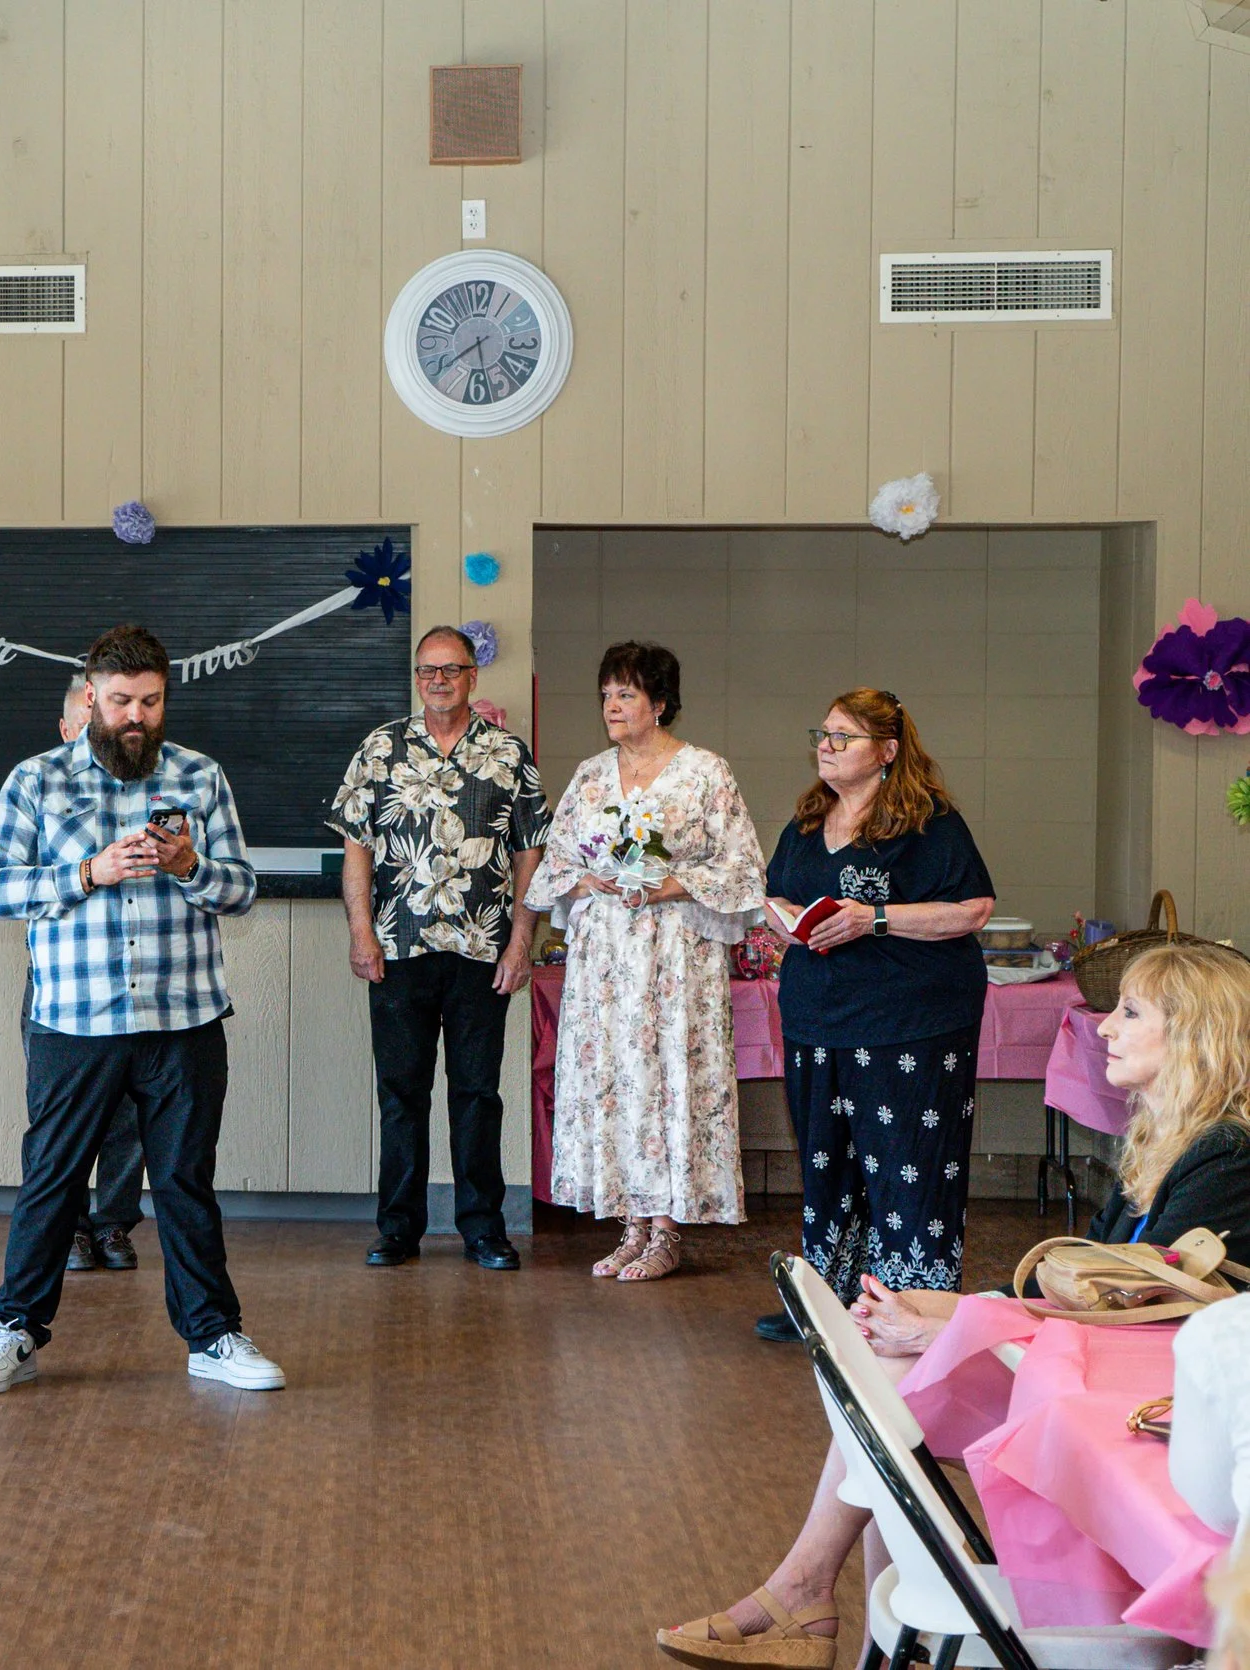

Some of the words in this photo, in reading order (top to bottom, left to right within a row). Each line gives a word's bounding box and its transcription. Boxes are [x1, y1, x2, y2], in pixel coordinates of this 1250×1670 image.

[468, 283, 489, 316] 12
[425, 307, 456, 333] 10
[419, 335, 449, 350] 9
[508, 337, 538, 350] 3
[426, 353, 453, 376] 8
[505, 355, 533, 376] 4
[446, 366, 469, 394] 7
[469, 372, 486, 403] 6
[491, 366, 510, 397] 5
